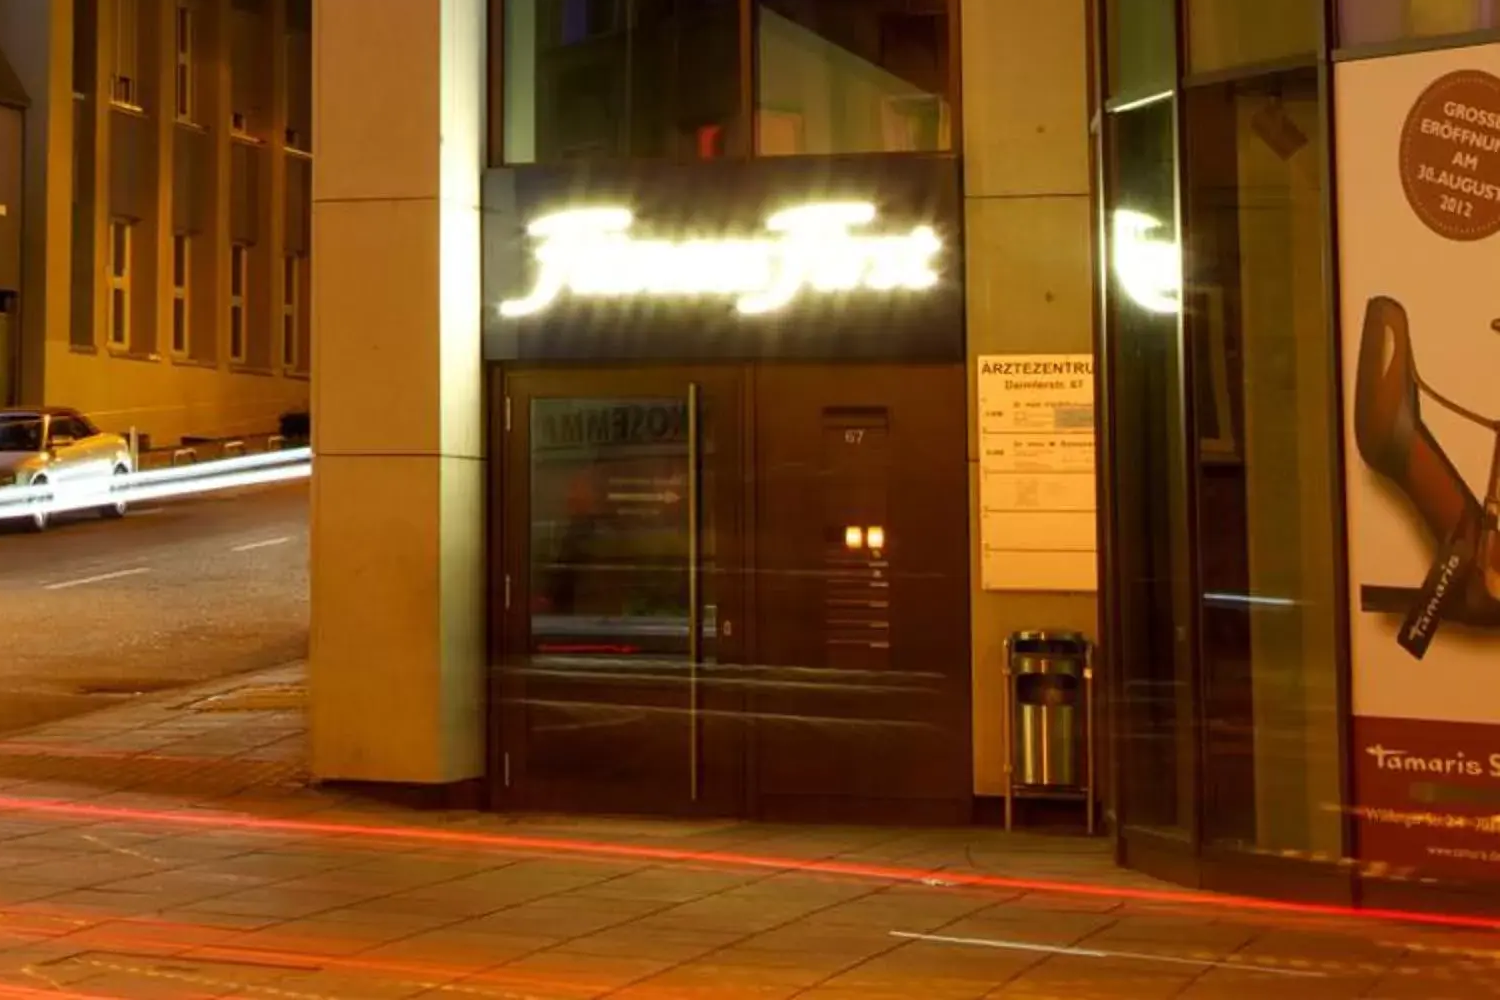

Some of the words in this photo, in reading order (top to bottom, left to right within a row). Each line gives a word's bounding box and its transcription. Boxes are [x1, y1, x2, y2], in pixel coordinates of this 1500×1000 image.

[1451, 151, 1479, 171] AM
[1439, 194, 1474, 218] 2012
[844, 429, 866, 445] 67
[1408, 555, 1460, 641] Tamaris
[1365, 743, 1483, 776] Tamaris
